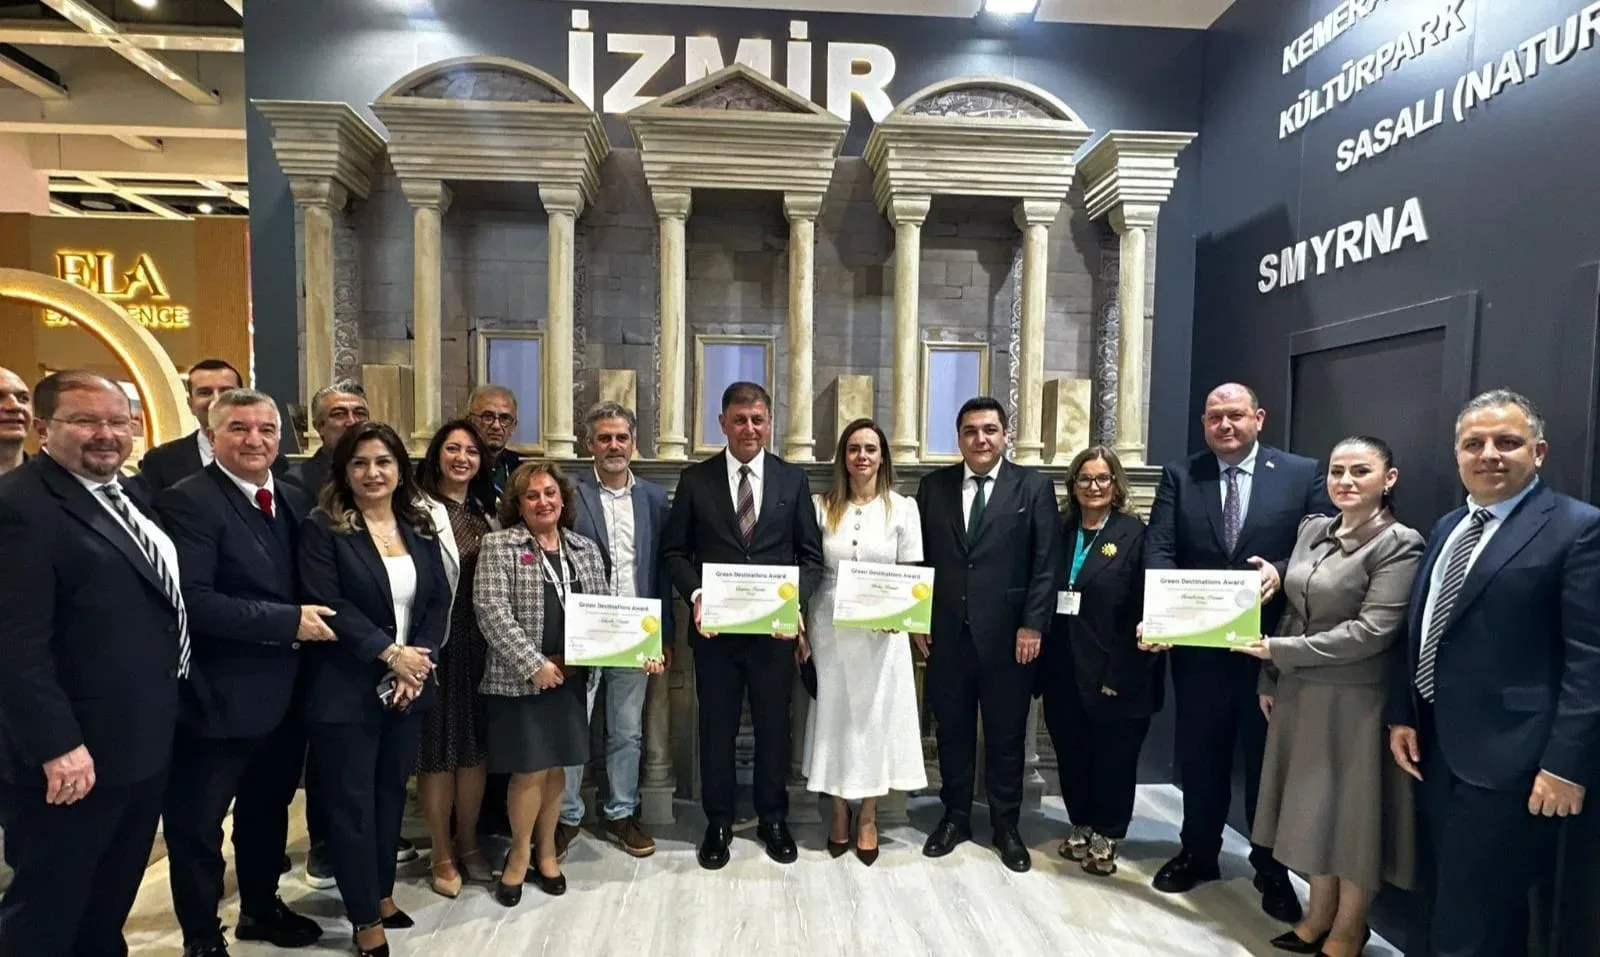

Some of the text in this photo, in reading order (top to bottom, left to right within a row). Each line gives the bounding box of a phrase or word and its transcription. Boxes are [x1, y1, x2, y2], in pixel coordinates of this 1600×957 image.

[568, 9, 897, 123] İZMİR
[1278, 0, 1466, 140] KÜLTÜRPARK
[1335, 89, 1445, 173] SASALI
[1258, 197, 1429, 294] SMYRNA
